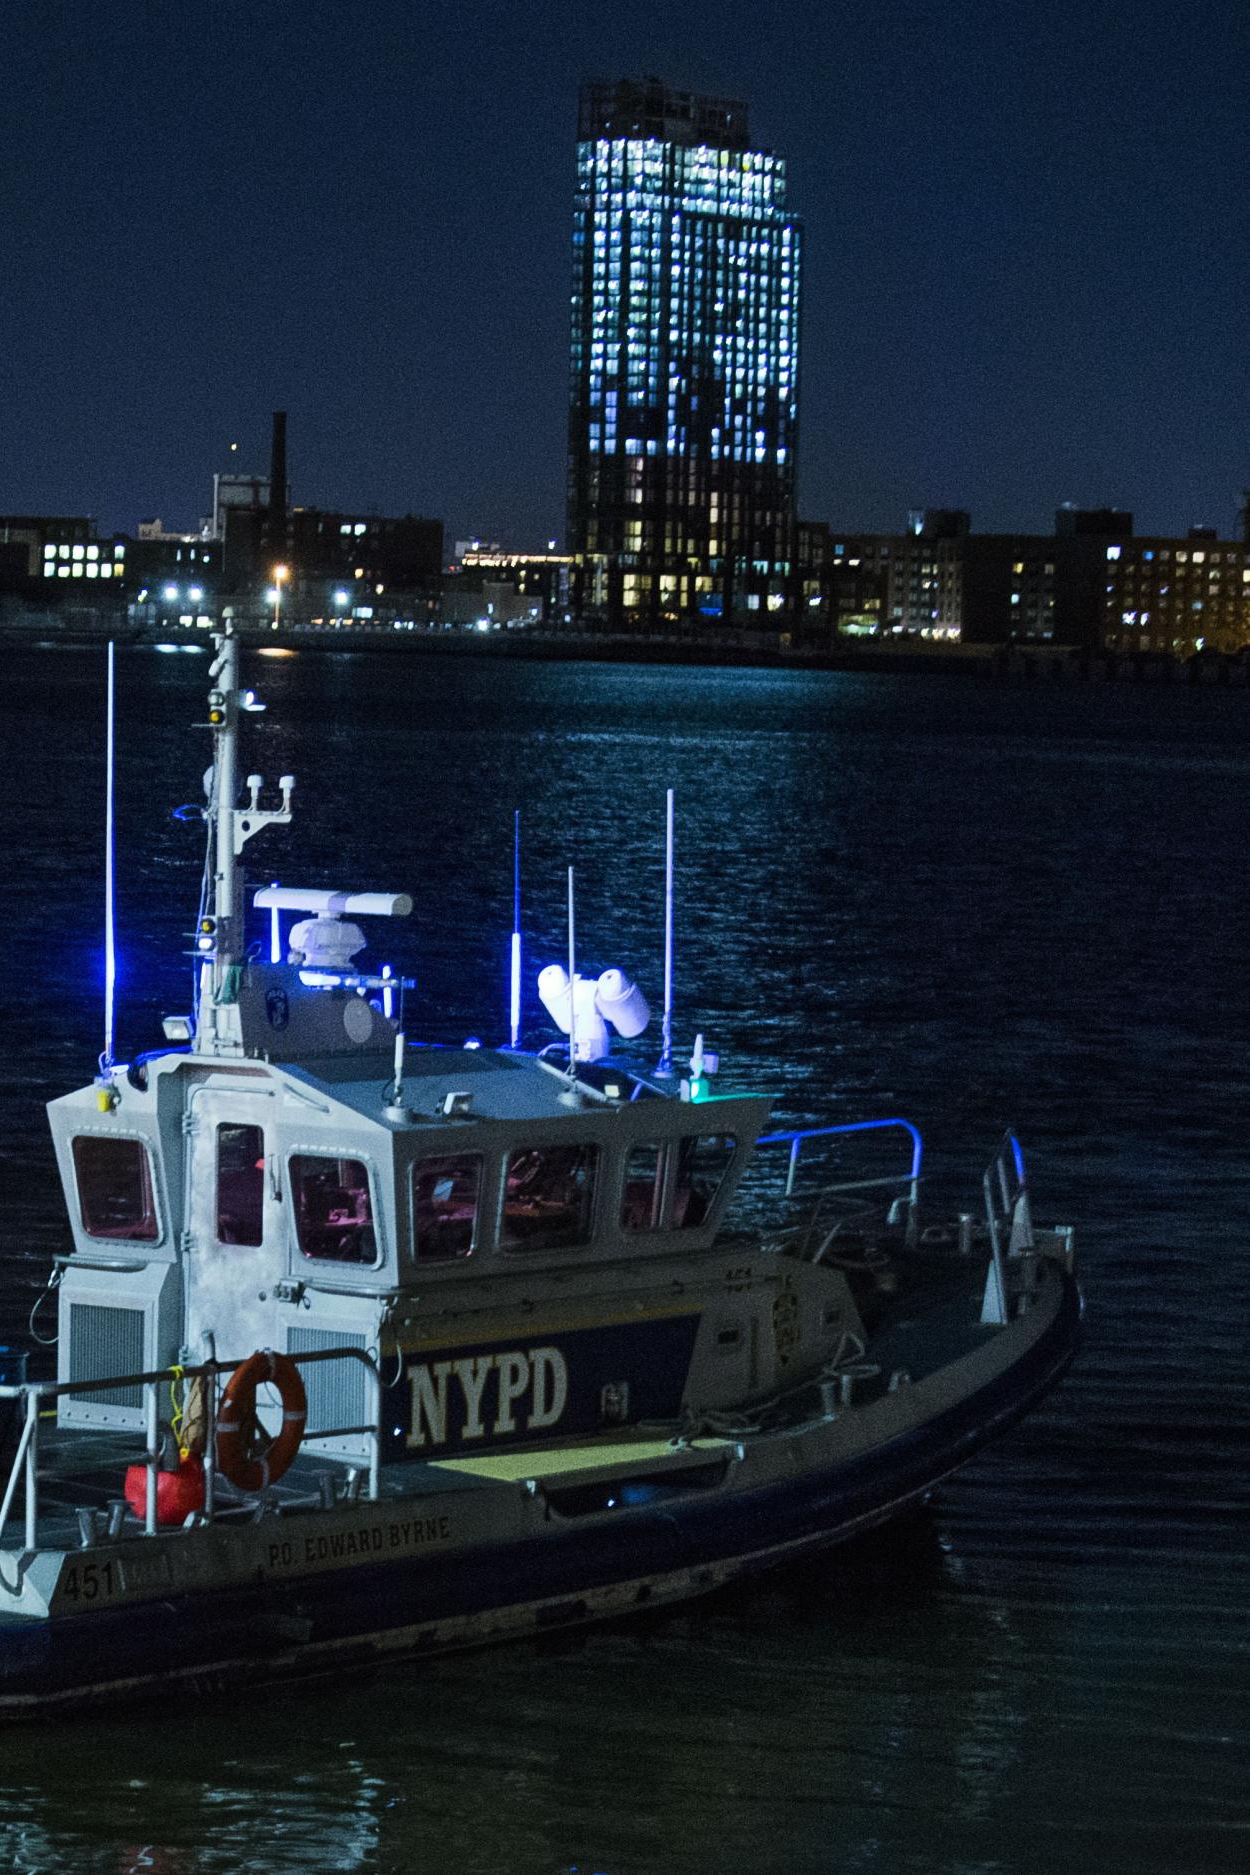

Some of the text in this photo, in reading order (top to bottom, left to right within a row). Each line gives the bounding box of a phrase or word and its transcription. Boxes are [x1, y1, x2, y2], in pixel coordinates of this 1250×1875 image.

[406, 1346, 567, 1448] NYPD
[305, 1529, 383, 1562] EDWARD
[389, 1517, 450, 1548] BYRNE
[64, 1561, 113, 1601] 451
